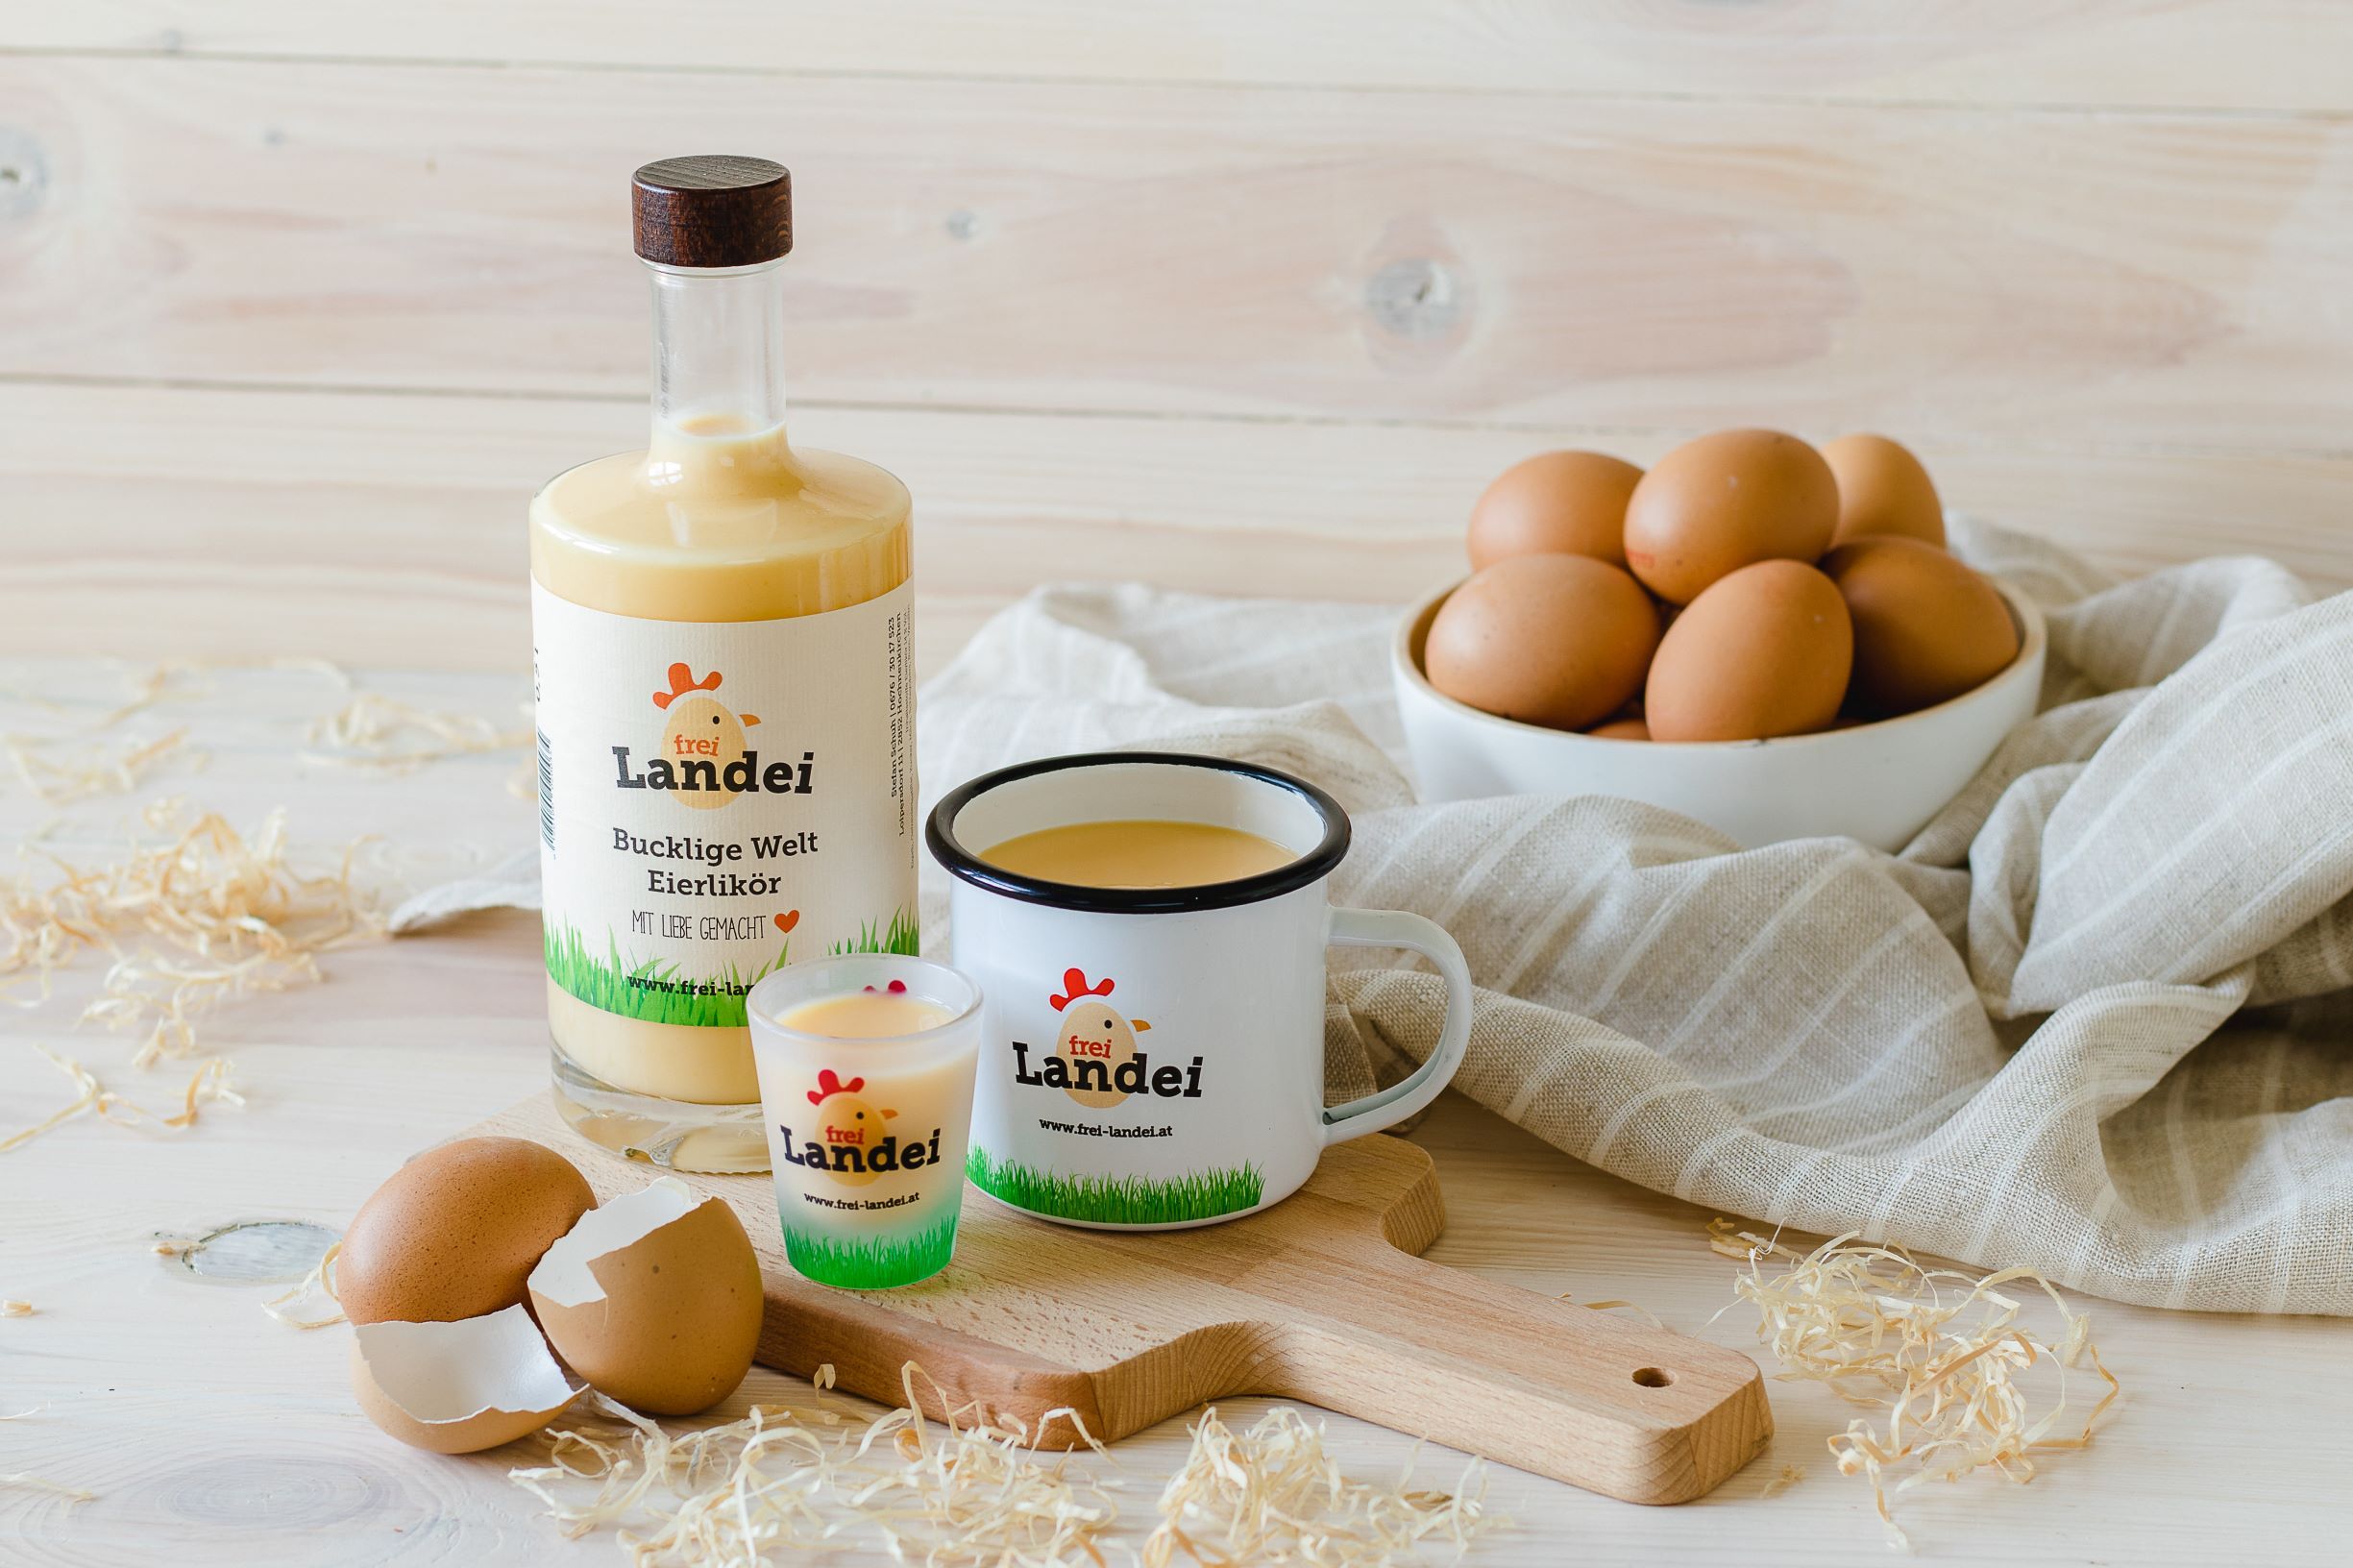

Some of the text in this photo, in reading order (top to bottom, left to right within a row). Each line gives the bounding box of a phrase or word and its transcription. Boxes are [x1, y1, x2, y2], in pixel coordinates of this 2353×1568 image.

[889, 642, 895, 653] 17
[889, 656, 895, 672] 30
[674, 734, 721, 757] frei
[612, 746, 814, 795] Landei
[613, 827, 819, 867] Bucklige Welt
[648, 870, 782, 897] Eierlikör
[632, 909, 767, 941] MIT LIEBE GEMACHT
[1068, 1035, 1112, 1060] frei
[1012, 1041, 1204, 1098] Landei
[825, 1124, 866, 1145] frei
[1039, 1117, 1173, 1139] www.frei-landei.at
[780, 1124, 941, 1173] Landei
[803, 1191, 920, 1211] www.frei-landei.at
